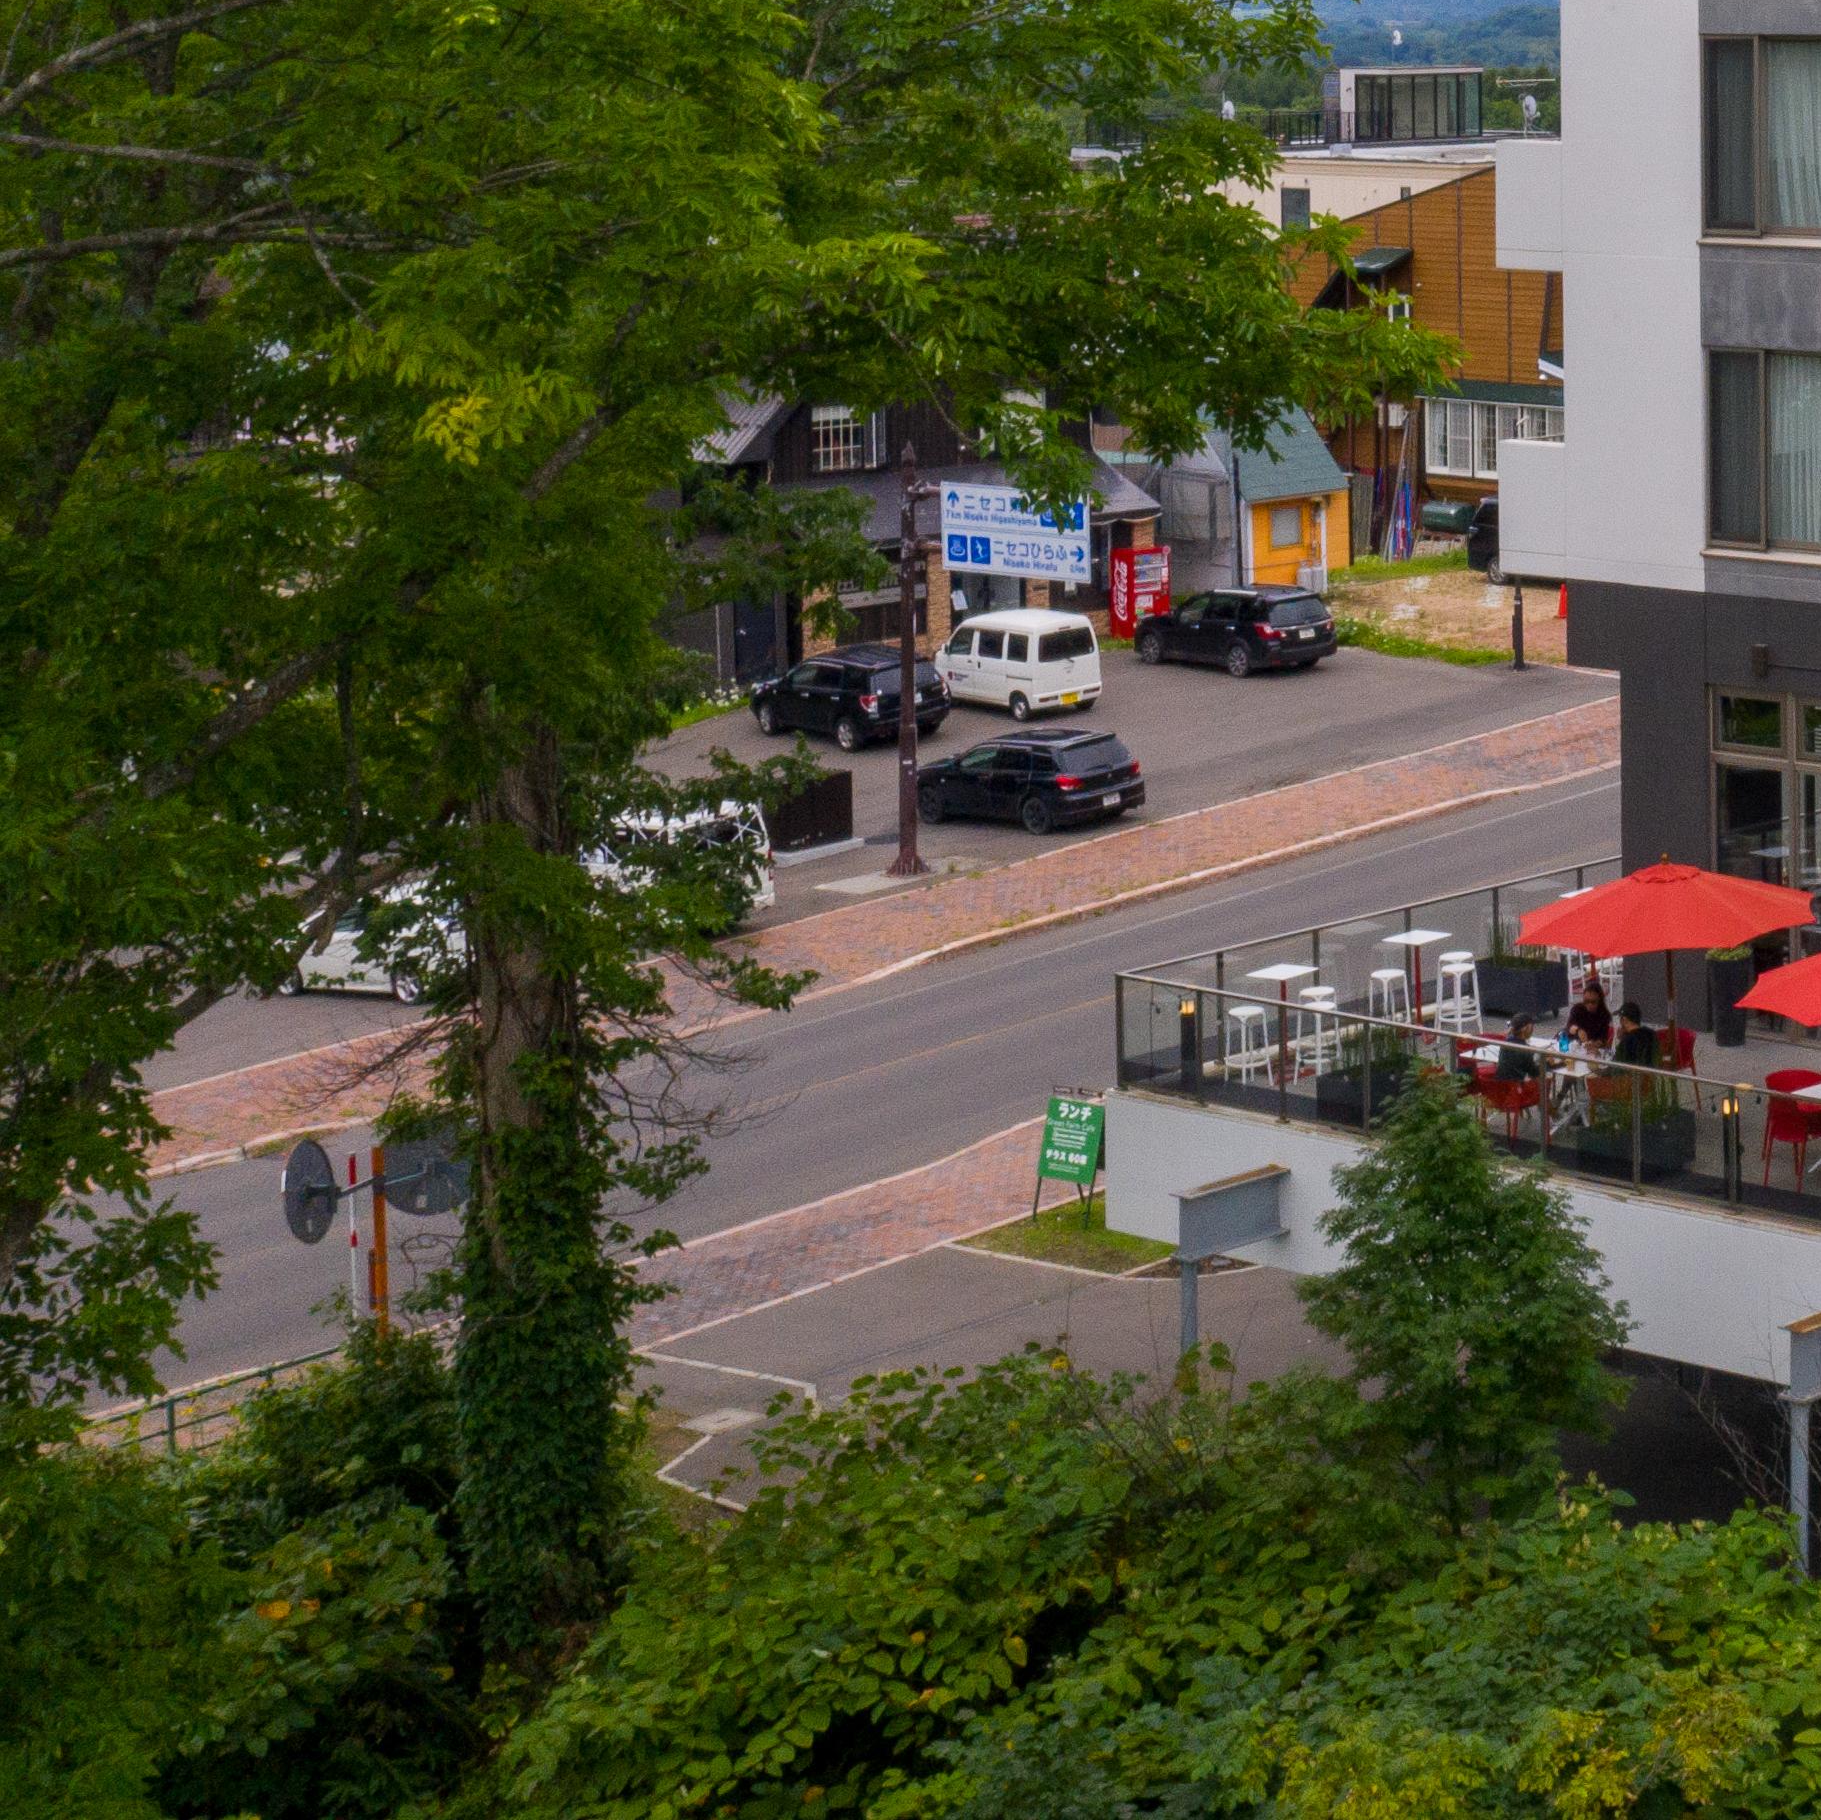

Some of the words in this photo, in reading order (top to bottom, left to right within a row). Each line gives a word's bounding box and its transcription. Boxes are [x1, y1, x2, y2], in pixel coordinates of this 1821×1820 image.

[963, 511, 989, 522] Niseko
[993, 540, 1068, 561] ニセコひらふ
[1003, 557, 1031, 569] Niseko
[1033, 560, 1058, 572] Hirafu
[1113, 558, 1128, 621] Coca-Cola
[1058, 1102, 1093, 1122] ランチ
